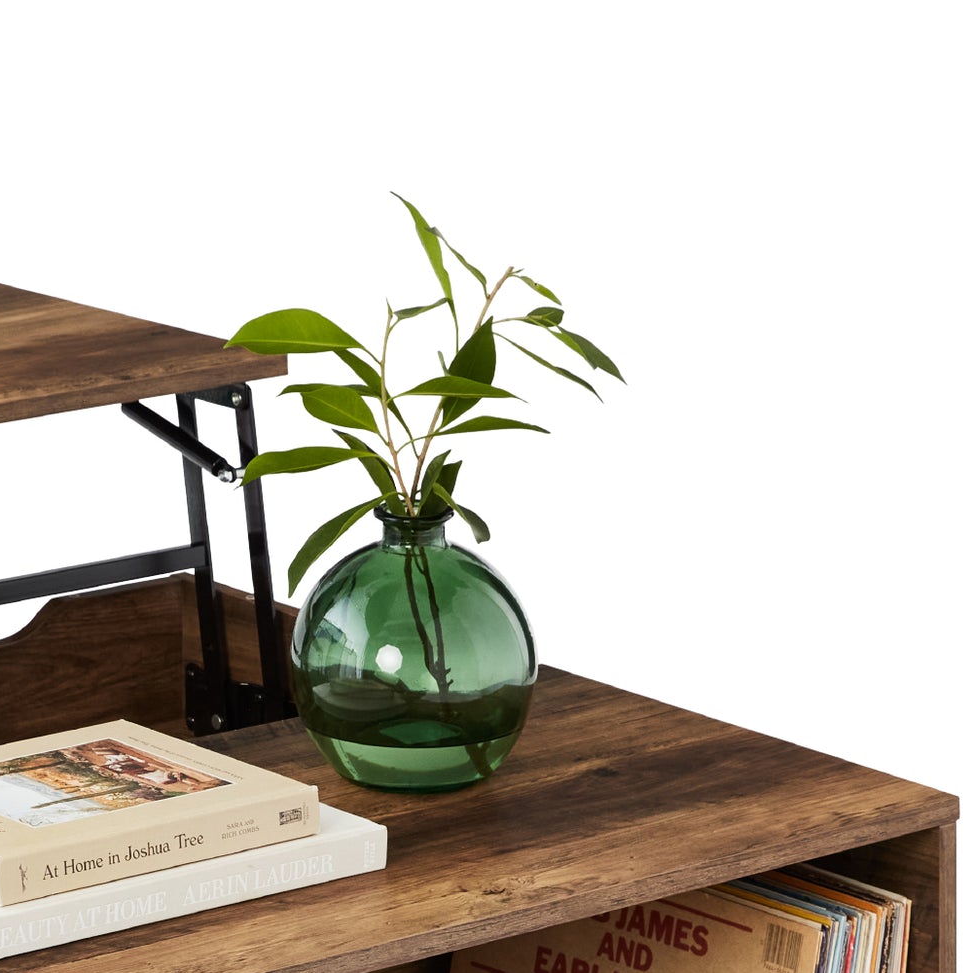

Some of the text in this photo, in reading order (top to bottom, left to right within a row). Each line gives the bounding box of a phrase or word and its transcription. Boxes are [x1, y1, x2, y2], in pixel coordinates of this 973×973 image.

[42, 833, 204, 880] At Home in Joshua Tree
[73, 905, 101, 932] AT
[104, 891, 167, 925] HOME
[182, 874, 248, 906] AERIN
[253, 853, 335, 890] LAUDER
[596, 931, 653, 972] AND
[615, 904, 709, 957] JAMES
